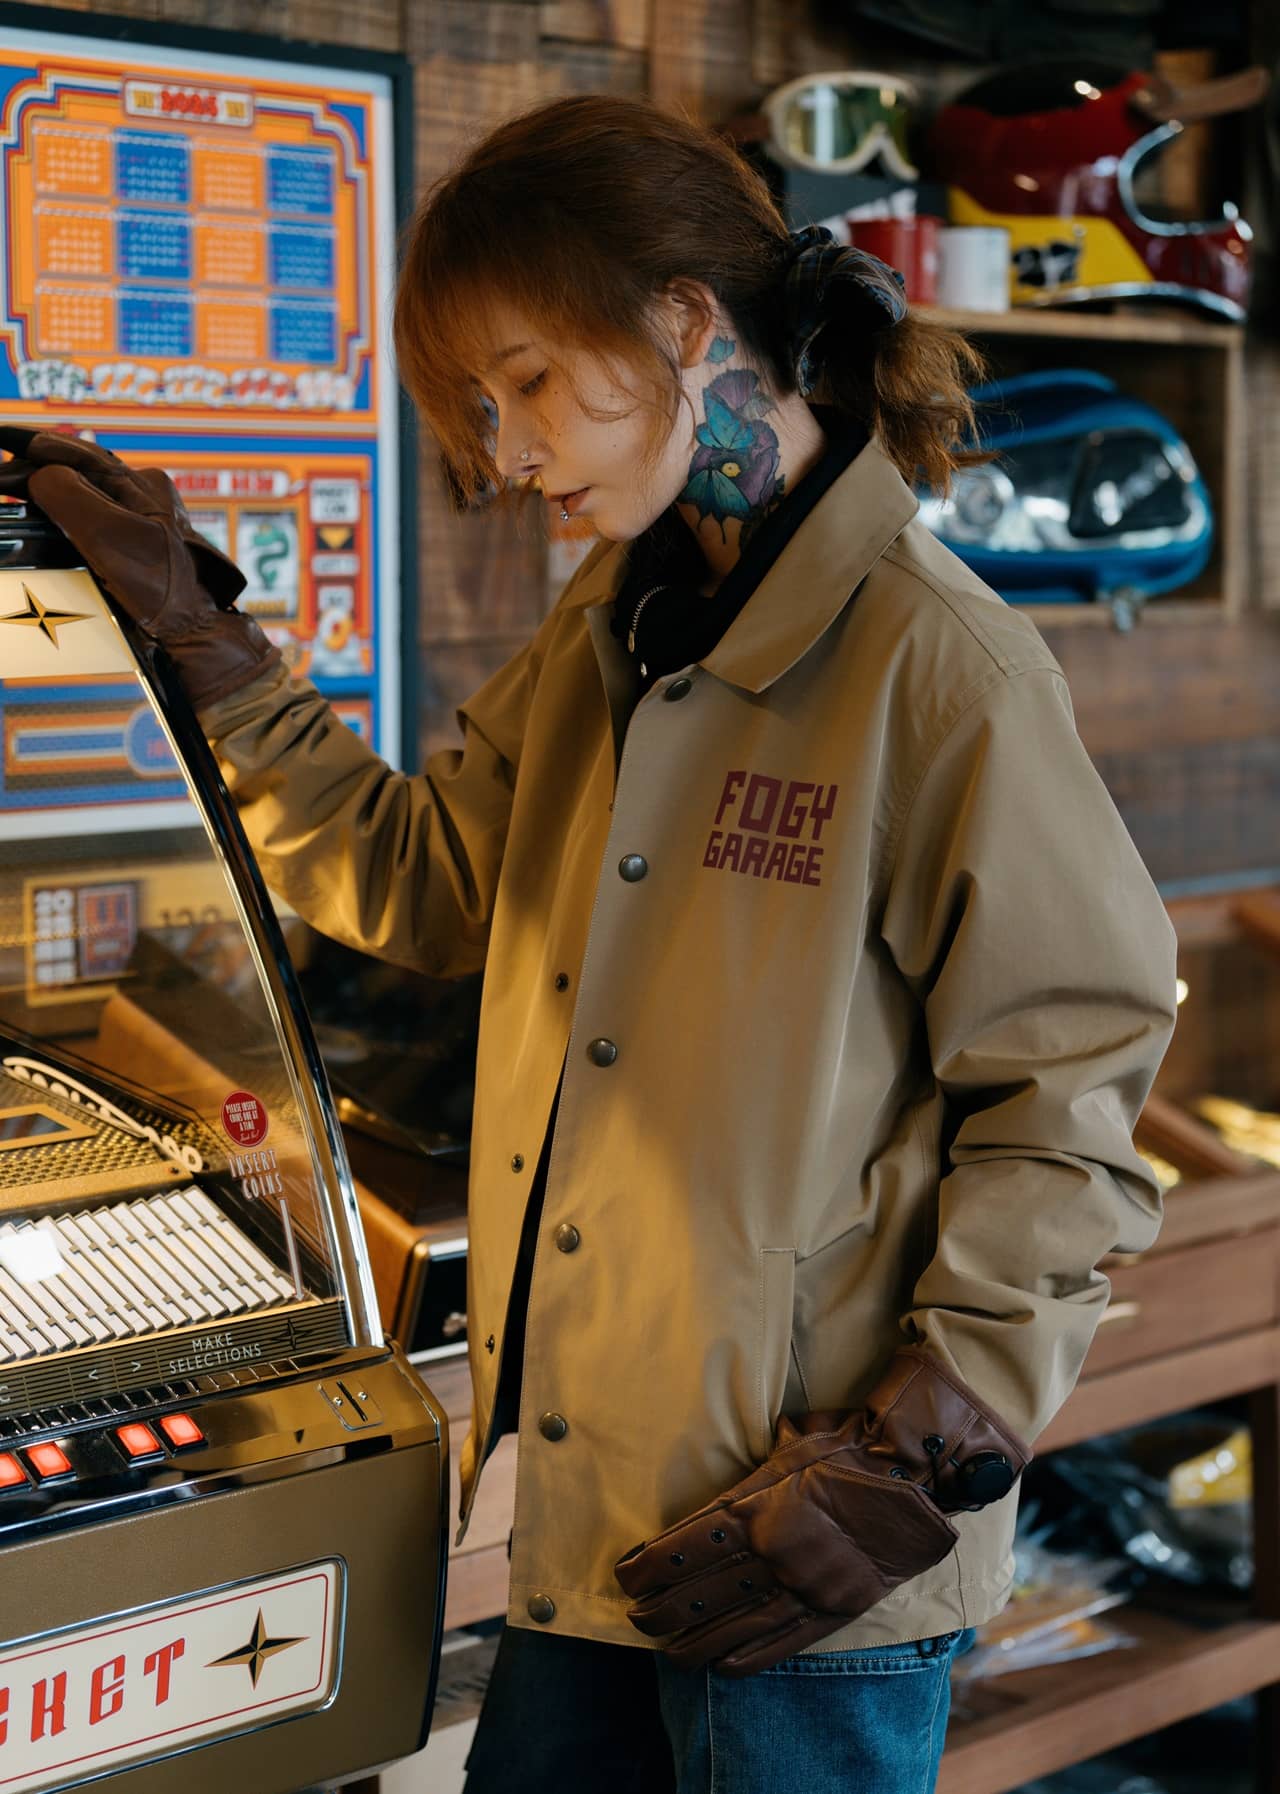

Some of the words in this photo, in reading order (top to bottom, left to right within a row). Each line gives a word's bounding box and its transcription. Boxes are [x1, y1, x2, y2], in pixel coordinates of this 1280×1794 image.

[714, 770, 838, 840] FOGY
[702, 830, 824, 887] GARAGE
[229, 1149, 277, 1178] INSERT
[242, 1172, 283, 1200] COINS
[192, 1332, 233, 1353] MAKE
[169, 1343, 262, 1375] SELECTIONS
[0, 1637, 186, 1746] KET
